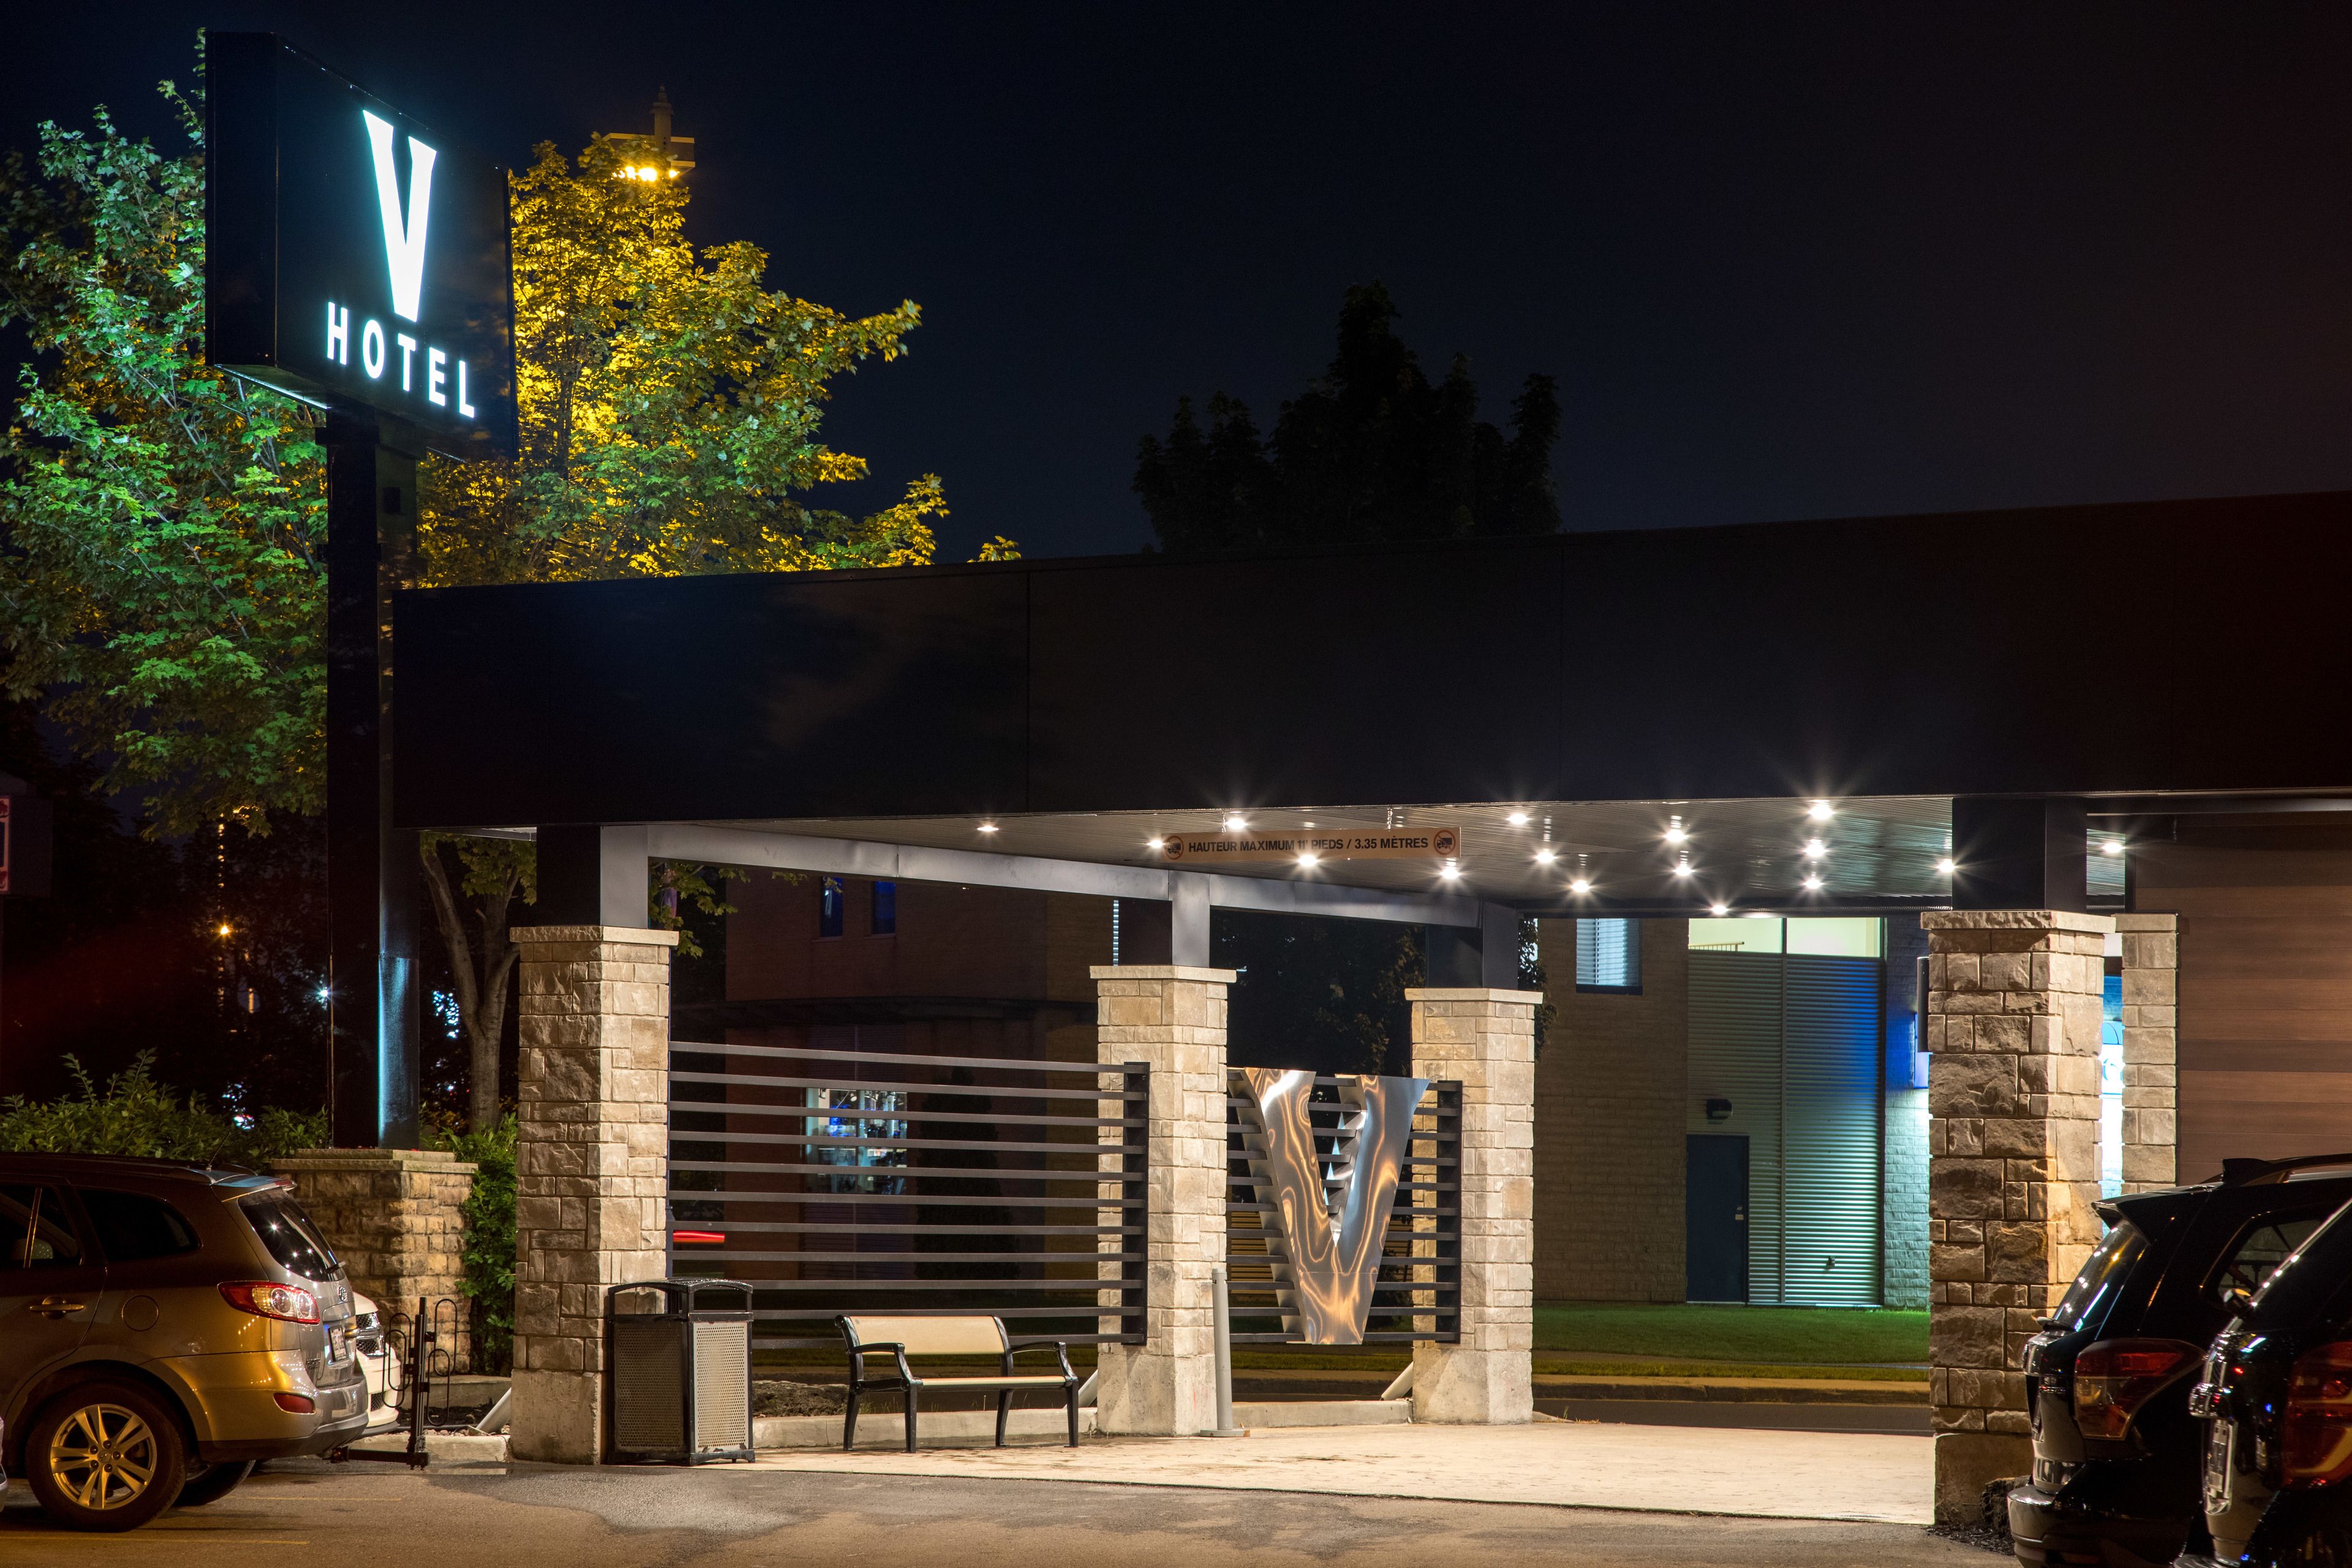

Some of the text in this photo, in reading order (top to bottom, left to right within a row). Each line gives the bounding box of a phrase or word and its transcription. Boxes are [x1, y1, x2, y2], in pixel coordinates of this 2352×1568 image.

[362, 109, 438, 323] V
[326, 301, 475, 419] HOTEL
[1188, 841, 1237, 853] HAUTEUR
[1240, 839, 1295, 851] MAXIMUM
[1311, 838, 1344, 850] PIEDS
[1346, 838, 1352, 850] /
[1354, 837, 1378, 850] 3.35
[1380, 835, 1429, 849] MÈTRES
[1229, 1066, 1430, 1345] V
